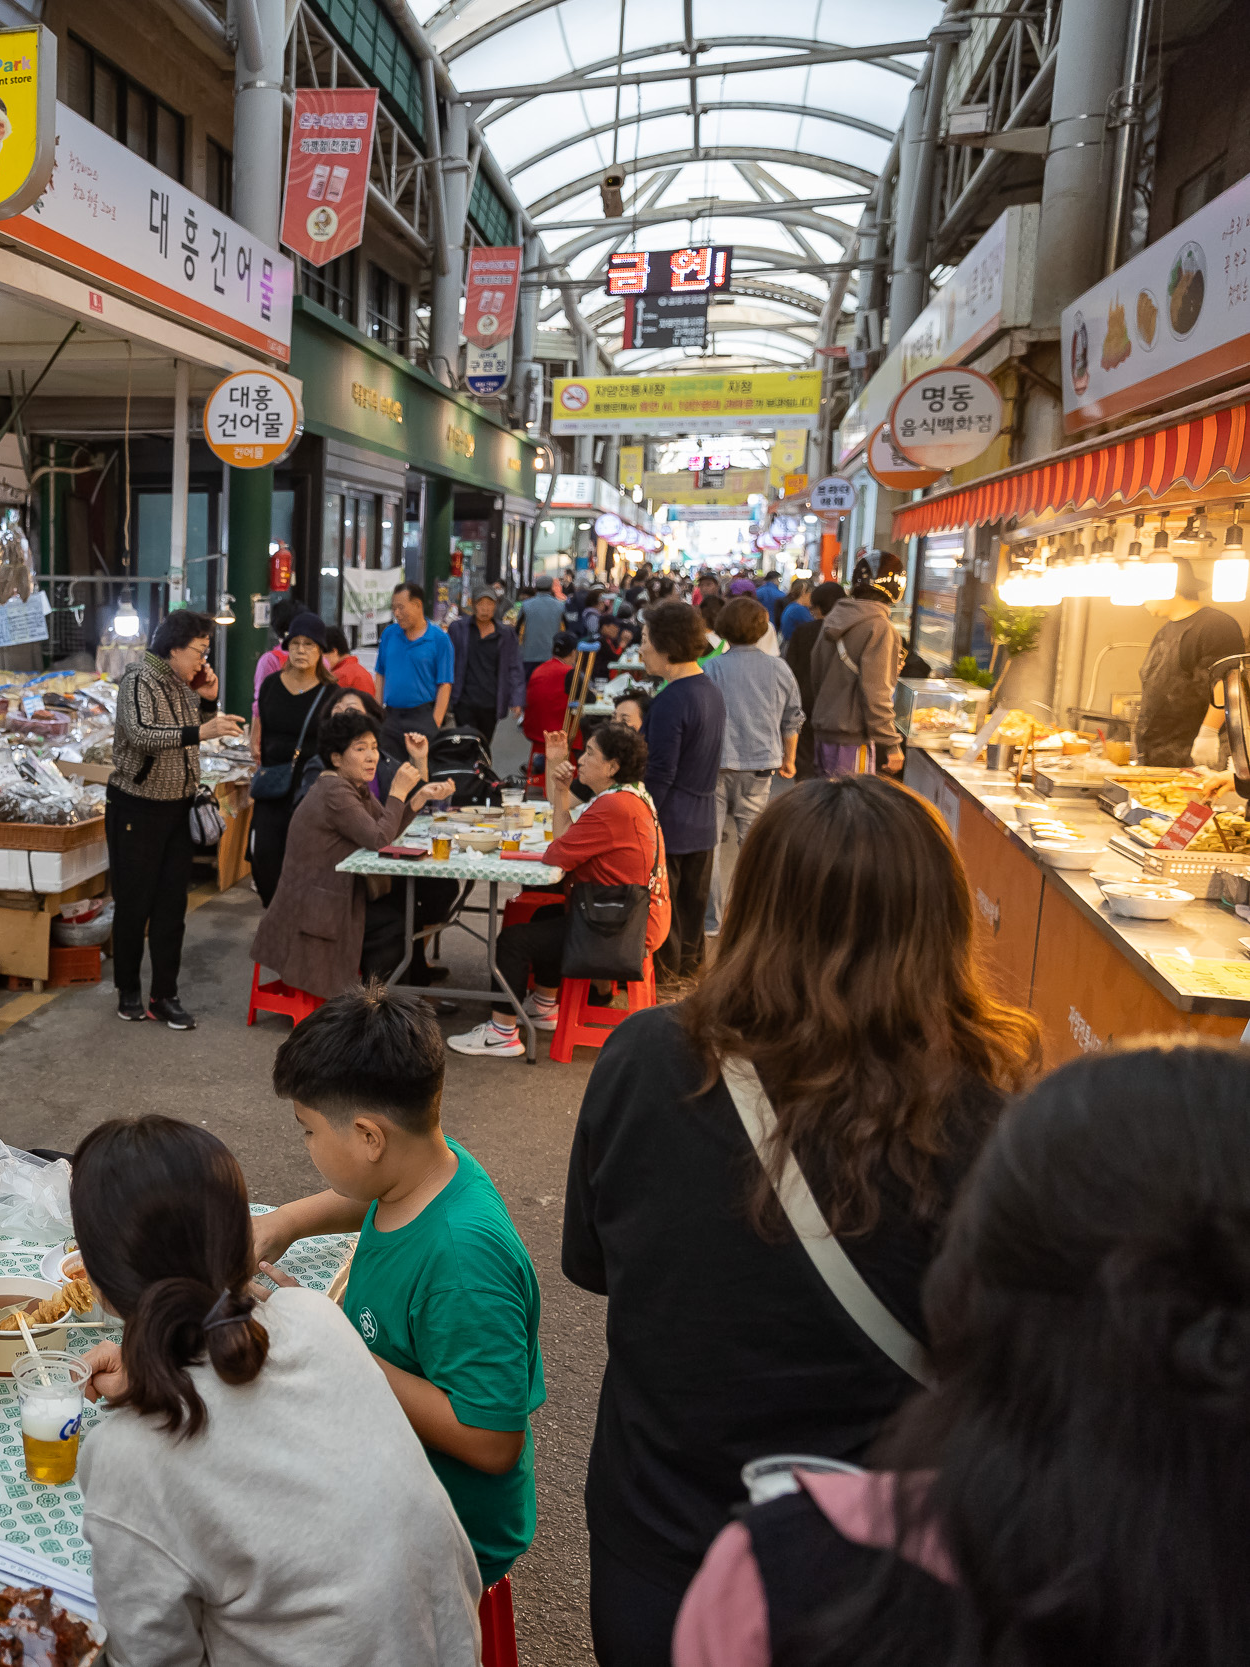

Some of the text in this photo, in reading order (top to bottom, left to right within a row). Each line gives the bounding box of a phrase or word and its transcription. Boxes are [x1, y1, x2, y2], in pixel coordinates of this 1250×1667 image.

[10, 76, 32, 85] store
[608, 252, 650, 294] 금
[229, 386, 273, 411] 대흥
[921, 385, 974, 412] 명동
[218, 413, 283, 438] 건어물
[901, 414, 992, 437] 음식백화점
[234, 446, 264, 460] 건어물
